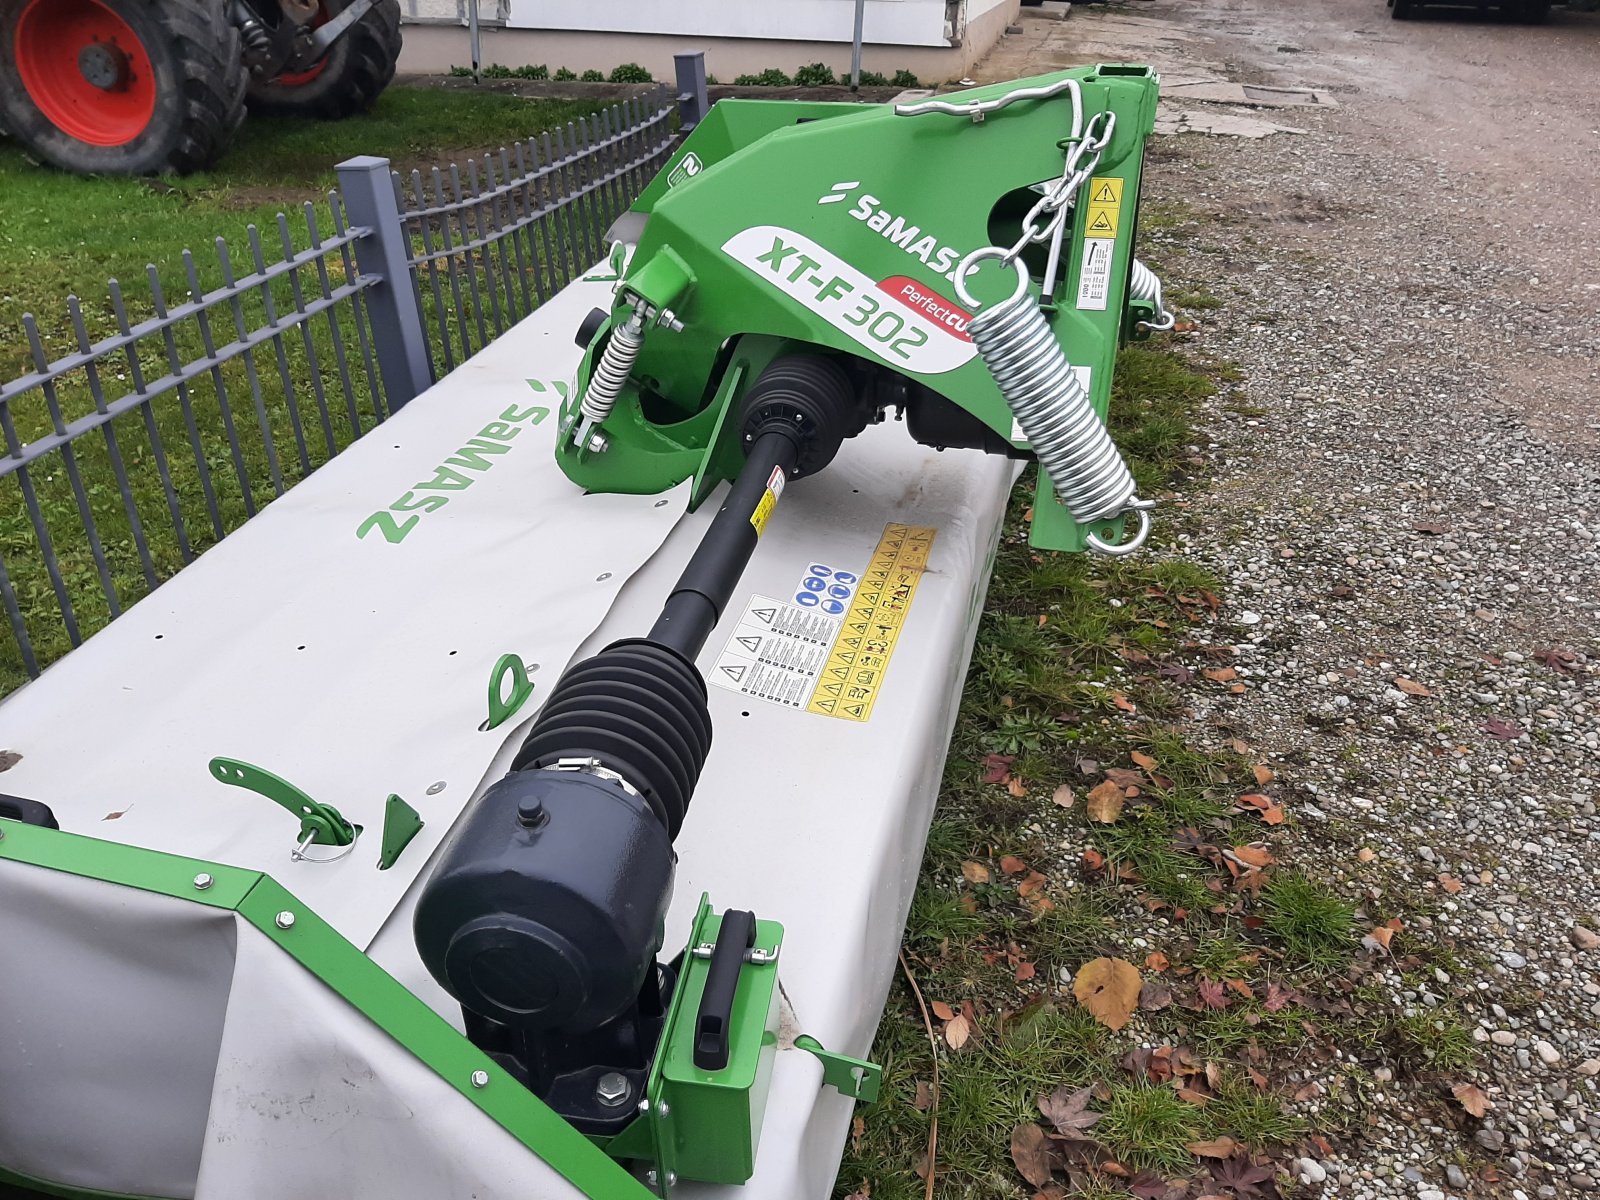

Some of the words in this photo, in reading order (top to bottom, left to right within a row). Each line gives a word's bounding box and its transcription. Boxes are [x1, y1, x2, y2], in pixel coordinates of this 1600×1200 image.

[755, 236, 855, 303] XT-F
[842, 294, 929, 360] 302
[901, 284, 970, 337] PerfectCU
[355, 403, 551, 545] SaMASZ
